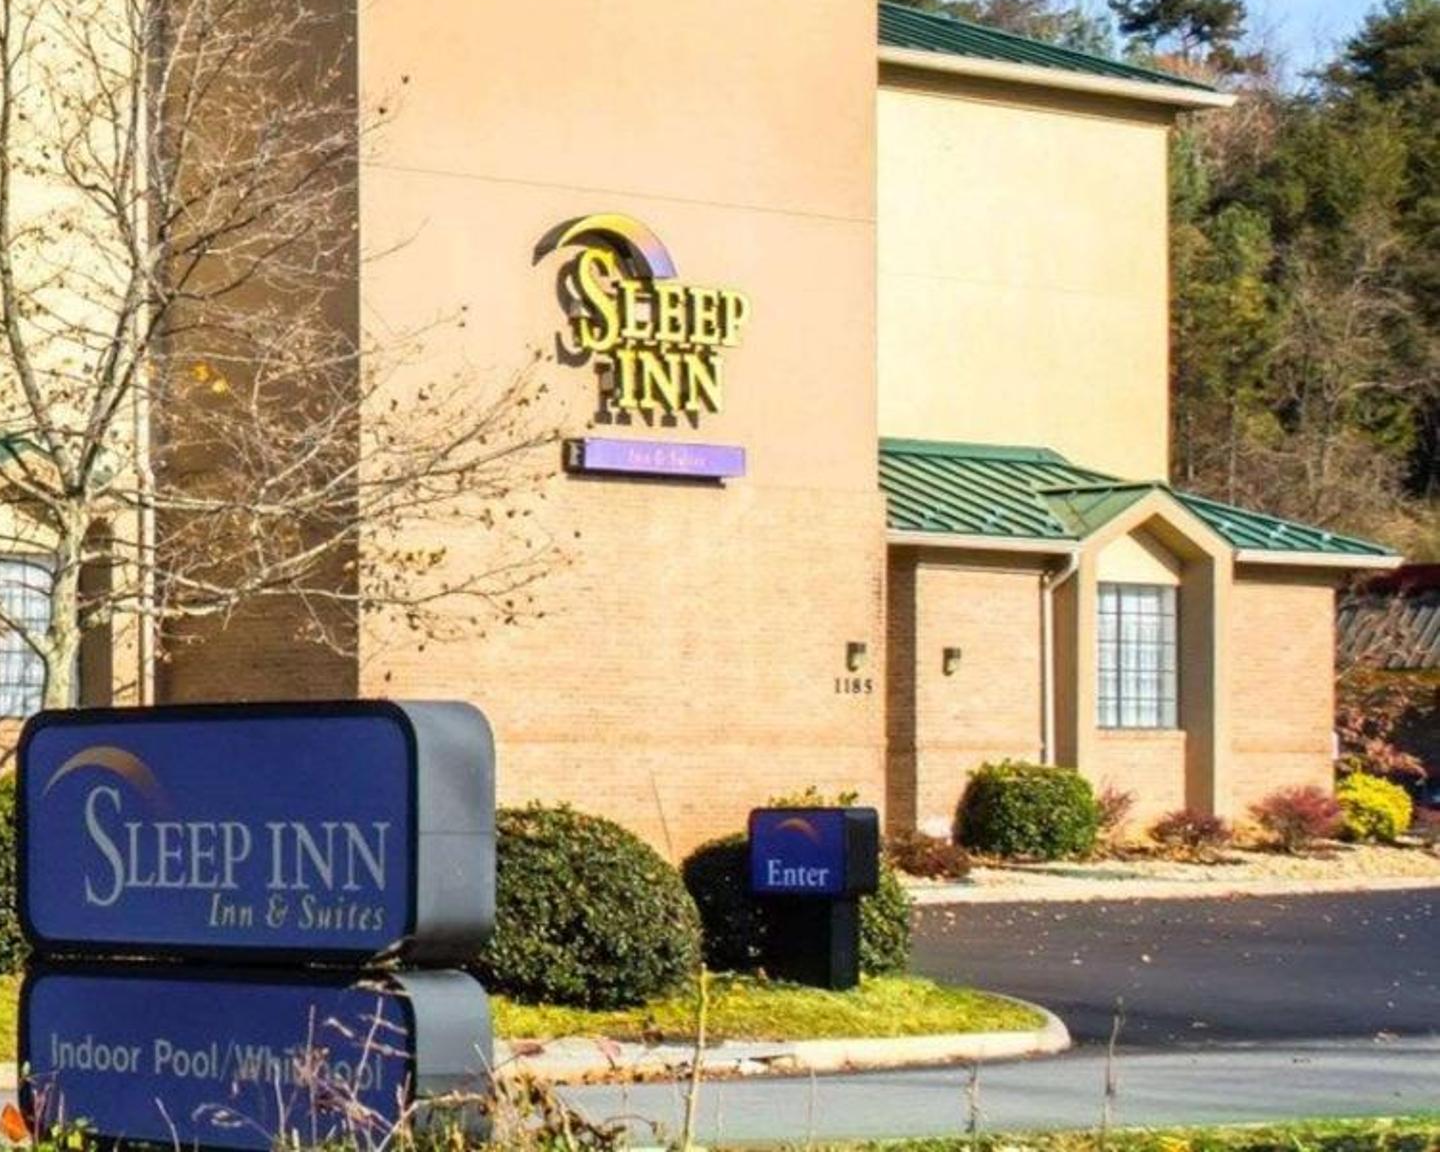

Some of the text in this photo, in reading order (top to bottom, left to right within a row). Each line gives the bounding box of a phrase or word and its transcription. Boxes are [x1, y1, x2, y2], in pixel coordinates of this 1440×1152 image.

[578, 248, 752, 351] SLEEP
[616, 348, 724, 413] INN
[833, 677, 873, 695] 1185
[84, 785, 391, 907] SLEEP INN
[767, 859, 830, 887] Enter
[209, 892, 386, 931] Inn & Suites
[50, 1032, 142, 1073] Indoor
